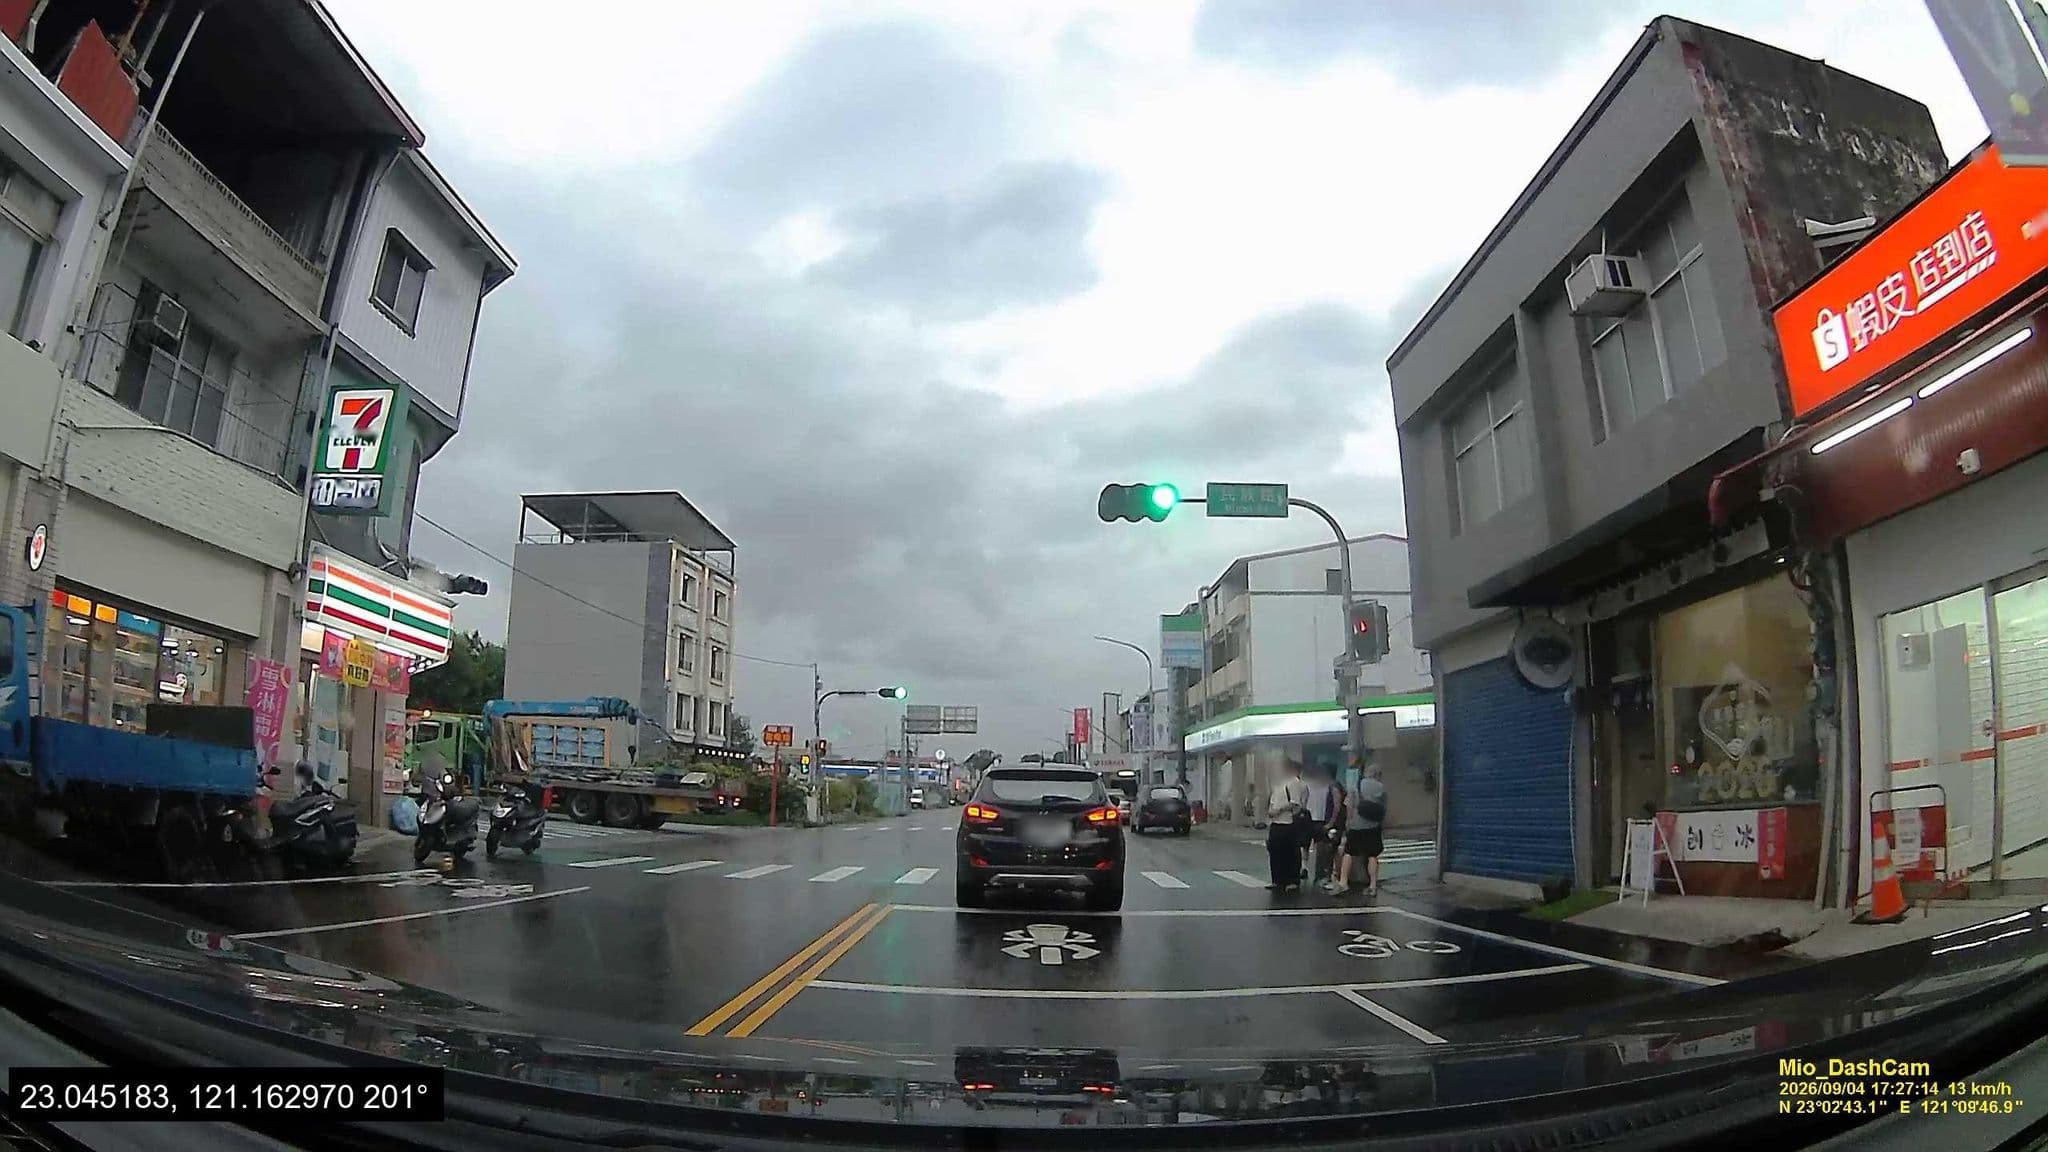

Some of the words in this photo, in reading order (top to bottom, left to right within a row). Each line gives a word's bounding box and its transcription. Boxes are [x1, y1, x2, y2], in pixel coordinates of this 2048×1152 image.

[1846, 271, 1916, 352] 蝦皮
[1908, 209, 1994, 298] 店到店
[341, 398, 383, 470] 7
[1735, 823, 1755, 849] 冰
